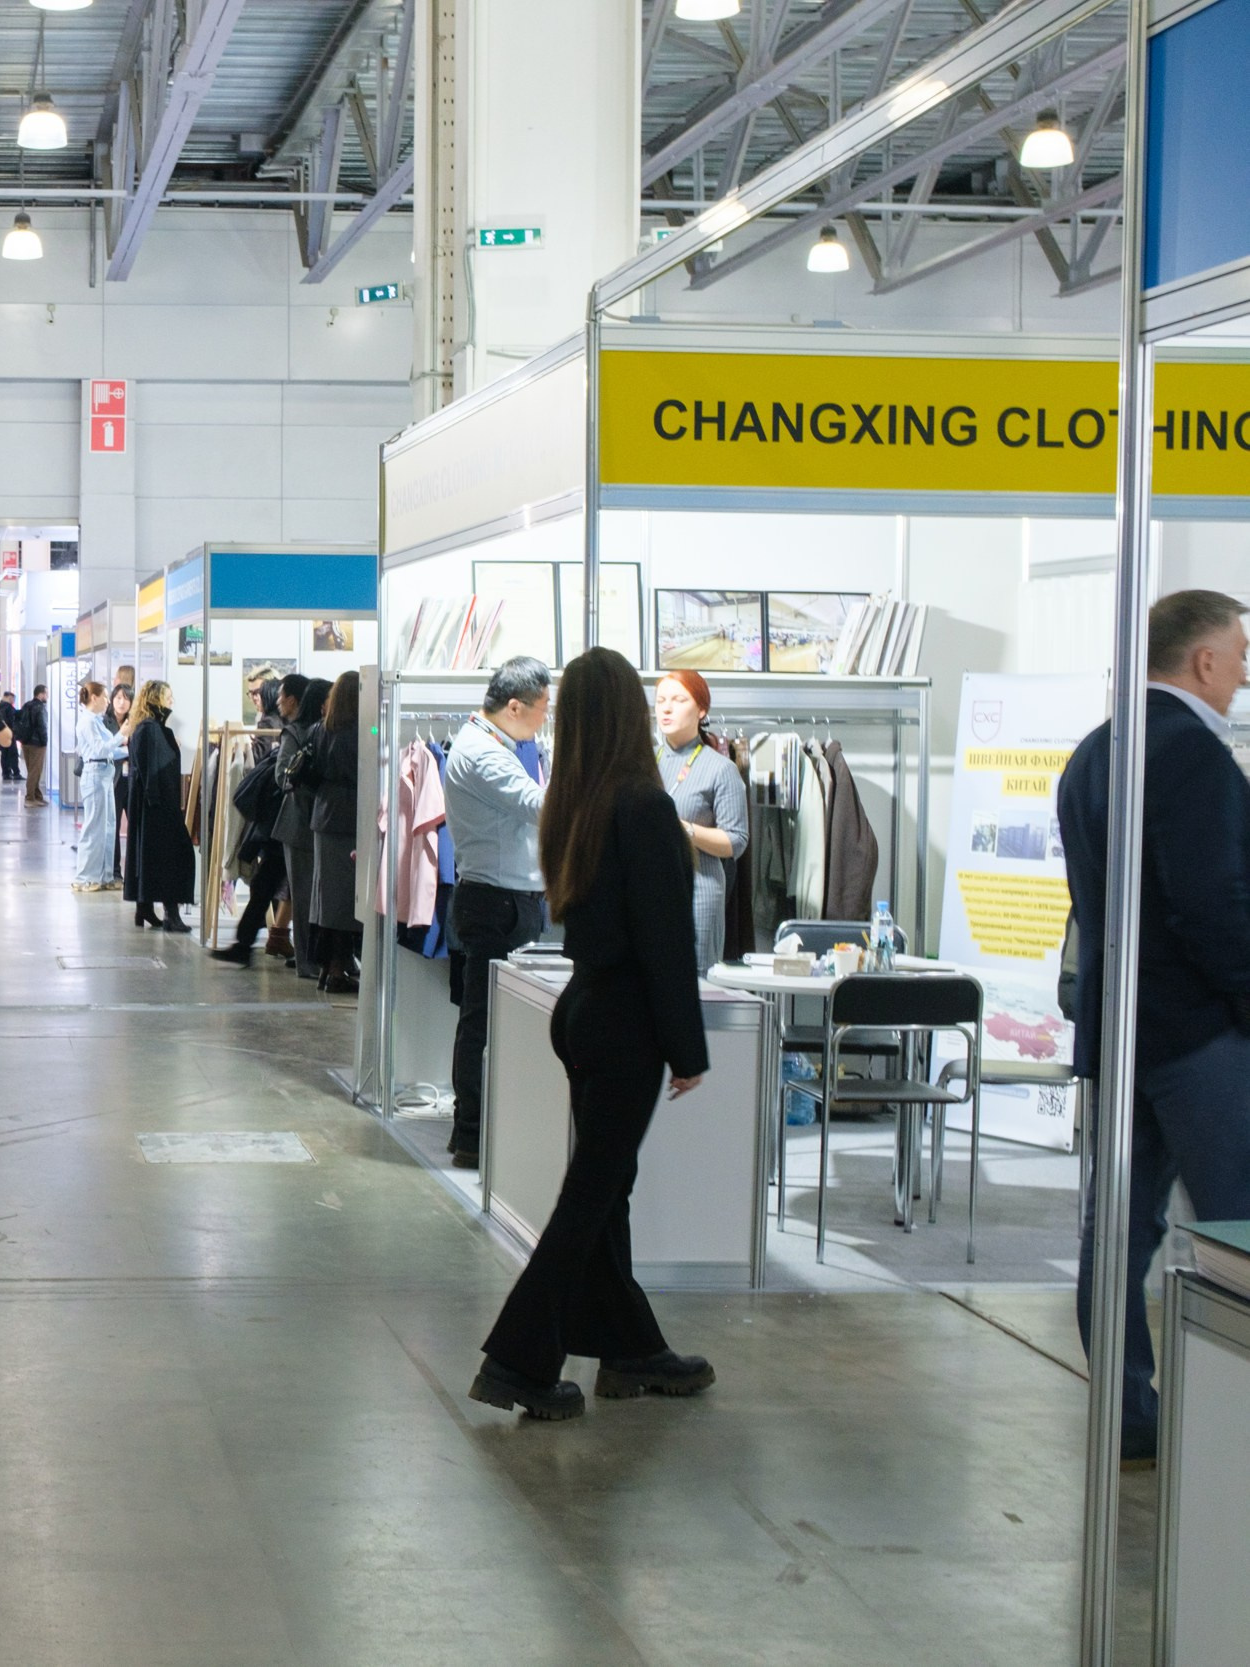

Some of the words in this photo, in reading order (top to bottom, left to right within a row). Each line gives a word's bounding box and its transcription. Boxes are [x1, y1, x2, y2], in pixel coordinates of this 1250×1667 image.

[653, 398, 978, 448] CHANGXING
[968, 750, 1028, 767] ШВЕЙНАЯ
[1005, 775, 1047, 792] КИТАЙ
